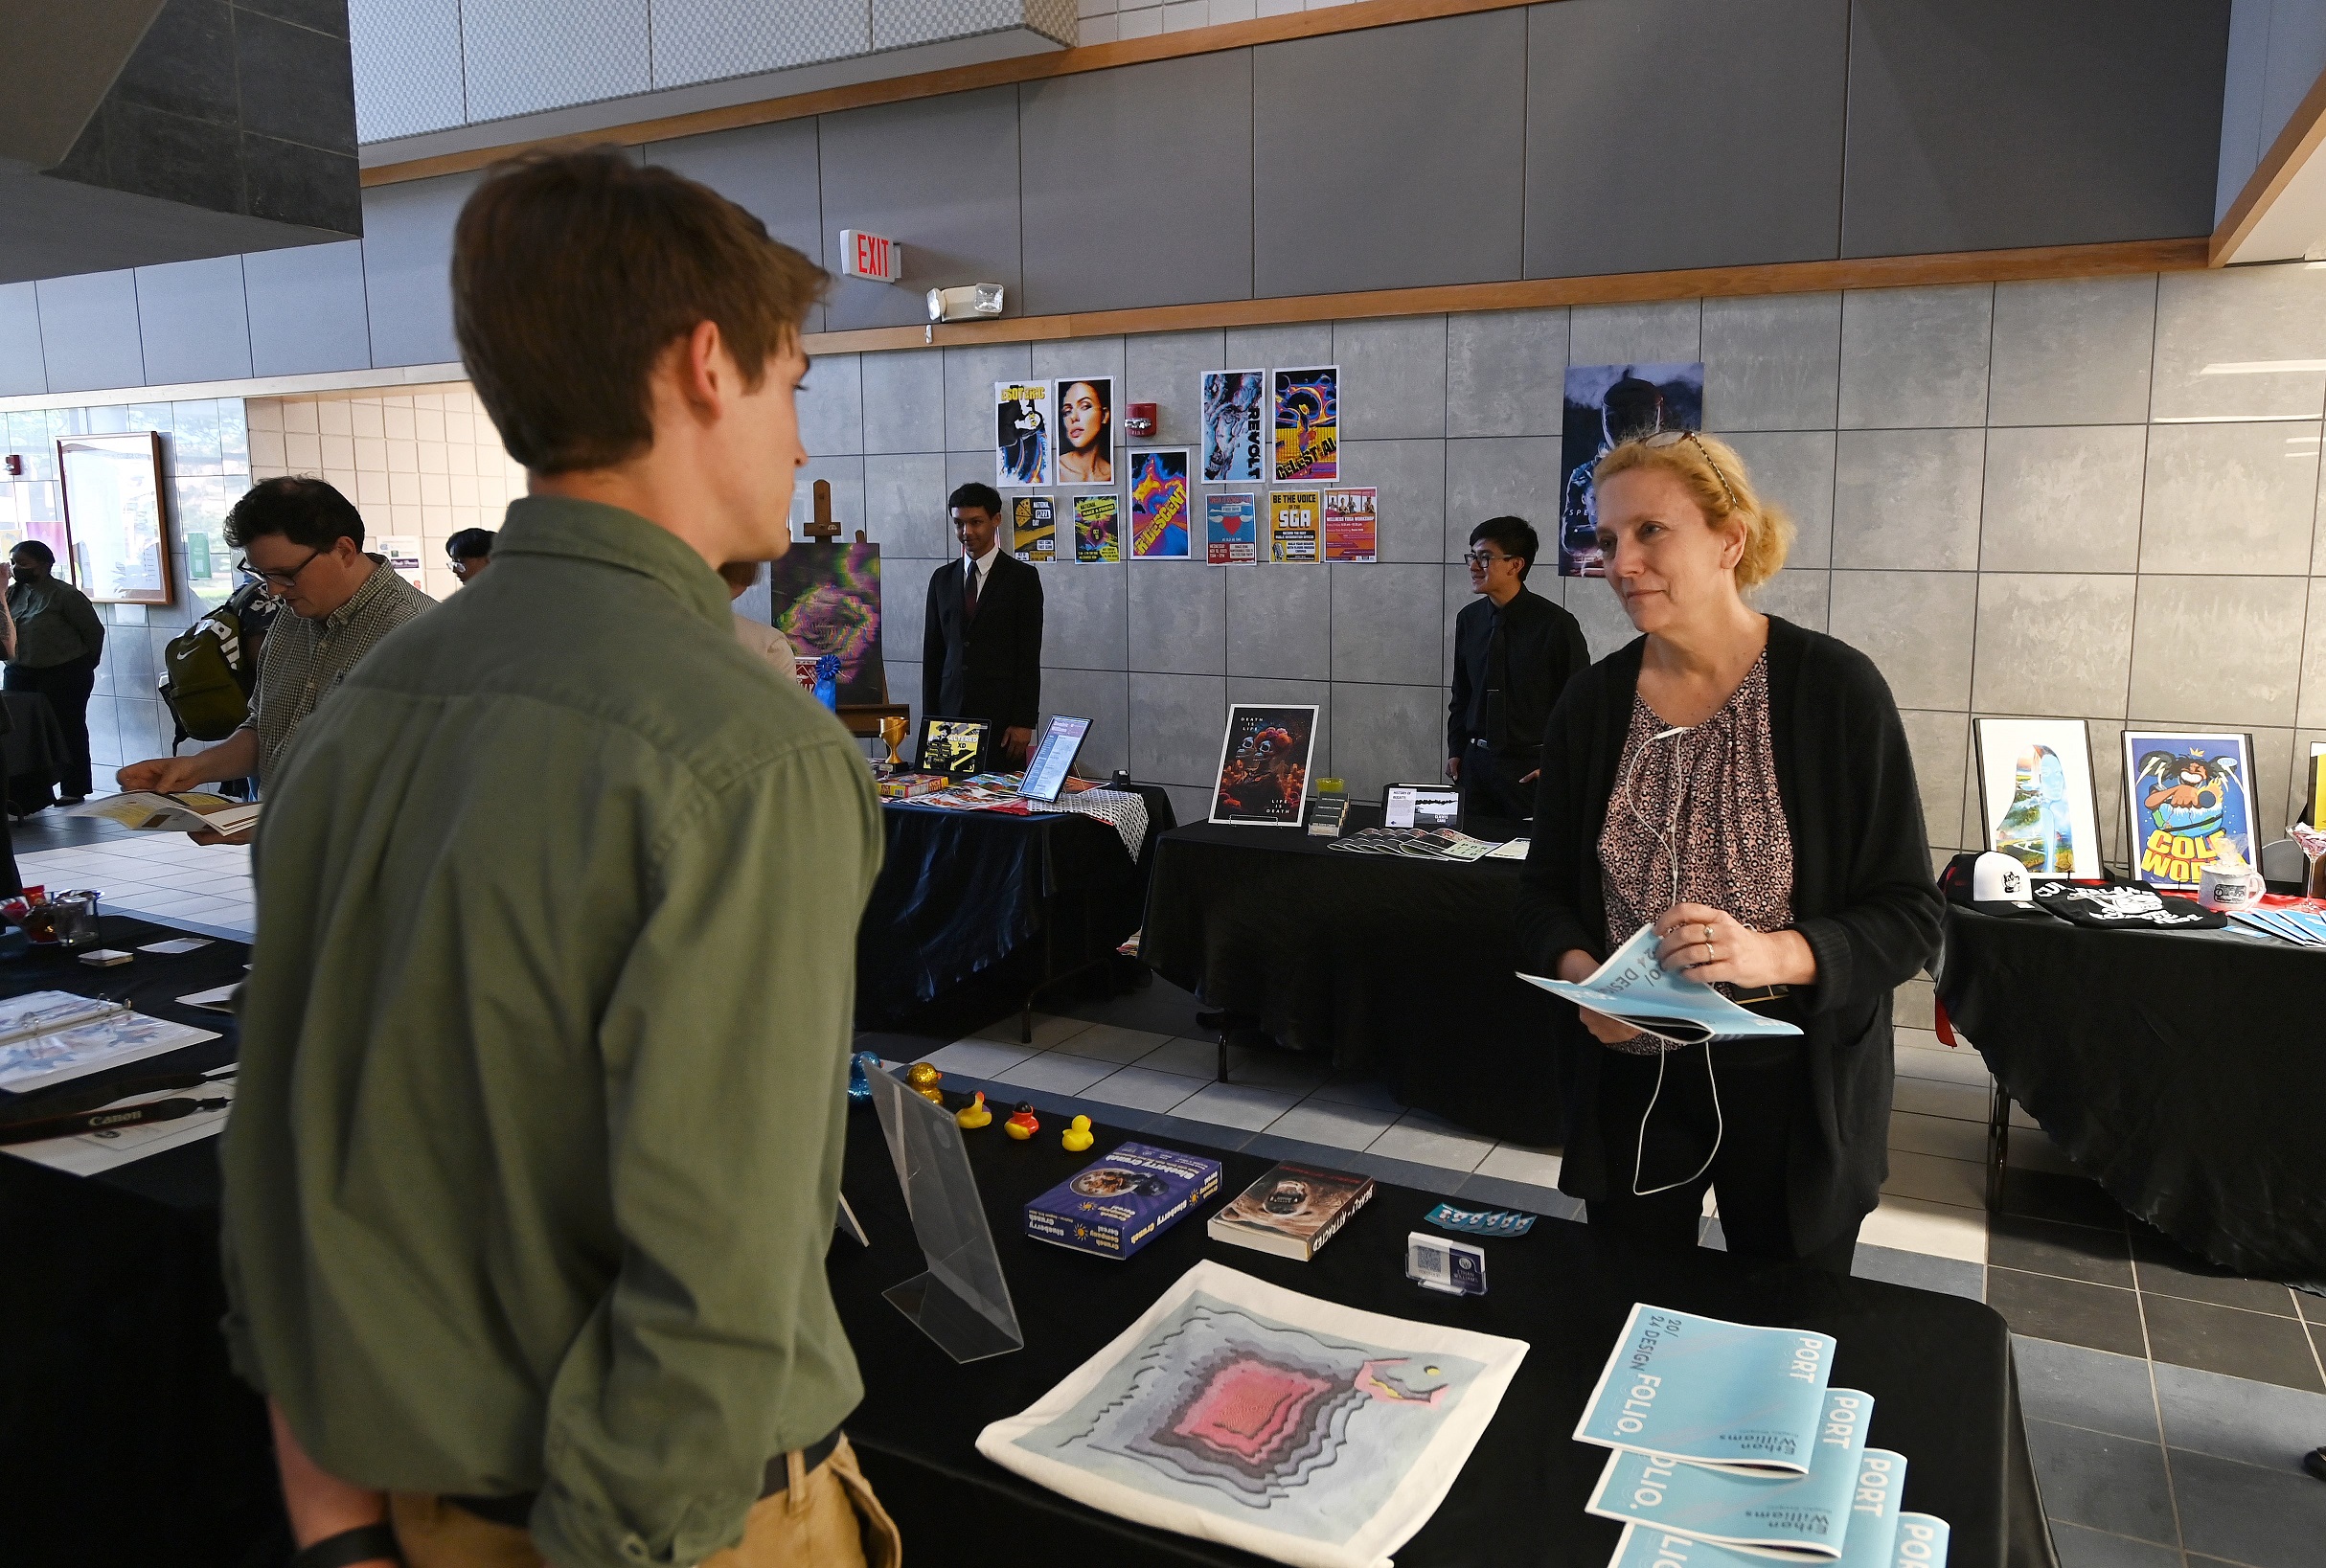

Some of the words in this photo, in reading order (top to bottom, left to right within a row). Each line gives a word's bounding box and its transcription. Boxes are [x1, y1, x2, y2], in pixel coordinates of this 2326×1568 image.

[856, 234, 889, 278] EXIT
[1000, 386, 1046, 401] ESOTERIC
[1247, 407, 1261, 479] REVOLT
[1272, 494, 1282, 504] BE
[1283, 494, 1296, 503] THE
[1297, 493, 1316, 503] VOICE
[1279, 510, 1311, 529] SGA
[88, 1111, 143, 1126] Canon
[1105, 1154, 1143, 1166] Crunch
[1141, 1160, 1196, 1180] Blueberry
[1351, 1183, 1375, 1214] BEARLY
[1028, 1214, 1055, 1226] Crunch
[1156, 1198, 1188, 1227] Blueberry
[1029, 1220, 1064, 1237] Blueberry
[1089, 1229, 1119, 1243] Company
[1097, 1225, 1119, 1237] Cereal
[1130, 1222, 1155, 1244] Crunch
[1311, 1210, 1348, 1253] ATTRACTED
[1095, 1238, 1120, 1250] Crunch
[1648, 1315, 1665, 1329] 24
[1662, 1318, 1682, 1338] 20/
[1630, 1329, 1658, 1372] DESIGN
[1789, 1336, 1823, 1385] PORT
[1612, 1373, 1662, 1437] FOLIO.
[1822, 1395, 1860, 1450] PORT
[1719, 1434, 1798, 1447] Williams
[1741, 1443, 1796, 1456] Ethan
[1630, 1456, 1678, 1511] OLIO.
[1854, 1458, 1892, 1518] PORT
[1744, 1511, 1830, 1526] Williams
[1767, 1521, 1830, 1534] Ethan
[1899, 1523, 1933, 1568] POR
